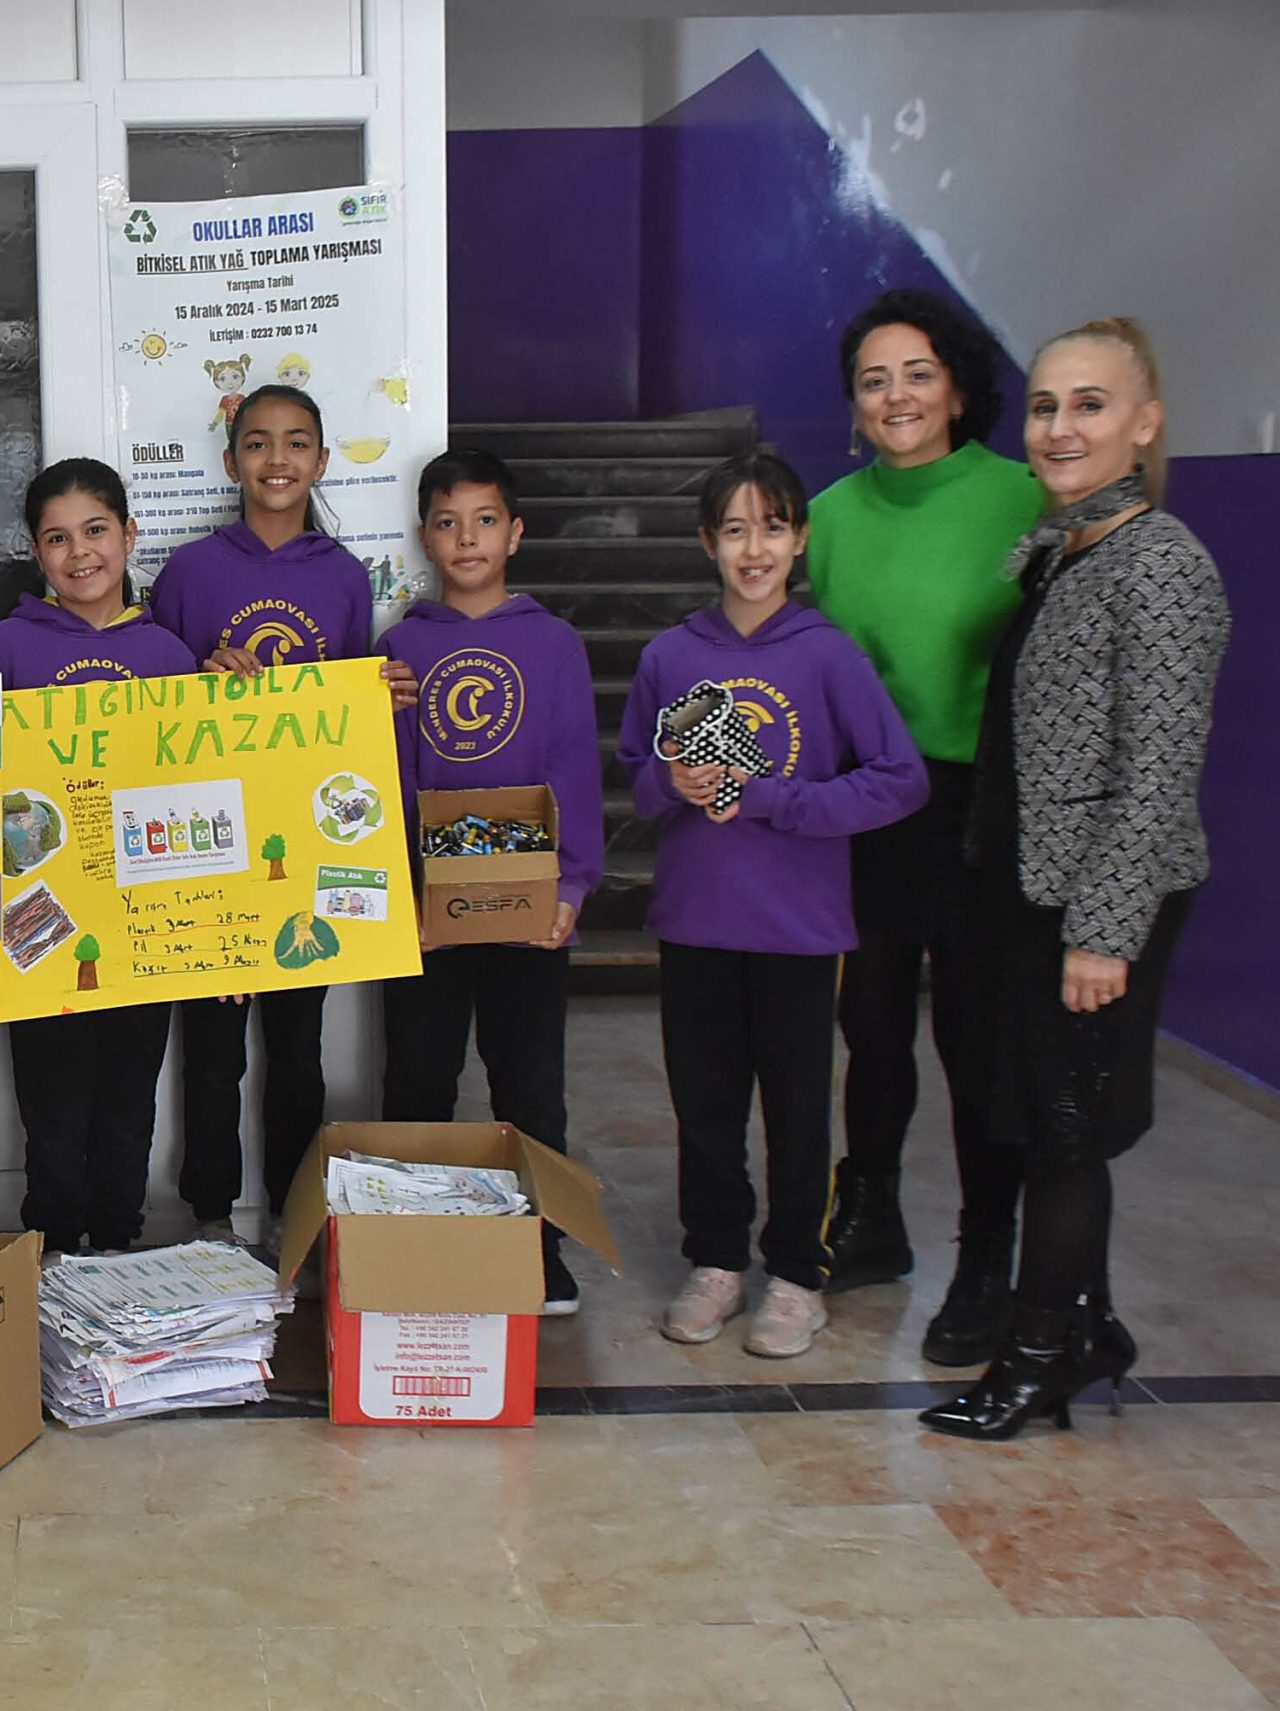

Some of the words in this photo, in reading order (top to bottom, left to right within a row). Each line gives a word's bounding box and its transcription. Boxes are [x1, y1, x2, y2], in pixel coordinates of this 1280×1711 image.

[192, 217, 263, 242] OKULLAR
[267, 212, 314, 237] ARASI
[136, 252, 187, 274] BİTKİSEL
[190, 254, 217, 271] ATIK
[220, 249, 245, 269] YAĞ
[250, 246, 310, 267] TOPLAMA
[312, 238, 383, 263] YARIŞMASI
[226, 278, 266, 294] Yarışma
[266, 274, 295, 289] Tarihi
[174, 306, 187, 320] 15
[190, 303, 224, 319] Aralık
[226, 301, 255, 317] 2024
[265, 300, 278, 314] 15
[280, 296, 308, 313] Mart
[310, 294, 340, 309] 2025
[209, 328, 244, 344] İLETİŞİM
[250, 326, 274, 340] 0232
[276, 324, 293, 338] 700
[294, 324, 304, 336] 13
[306, 322, 318, 335] 74
[132, 442, 184, 462] ÖDÜLLER
[230, 598, 320, 634] CUMAOVASI
[440, 658, 508, 679] CUMAOVASI
[47, 730, 110, 768] VE
[155, 704, 350, 767] KAZAN
[320, 868, 346, 879] Plastik
[216, 912, 233, 924] 28
[394, 1405, 413, 1417] 75
[418, 1405, 453, 1418] Adet
